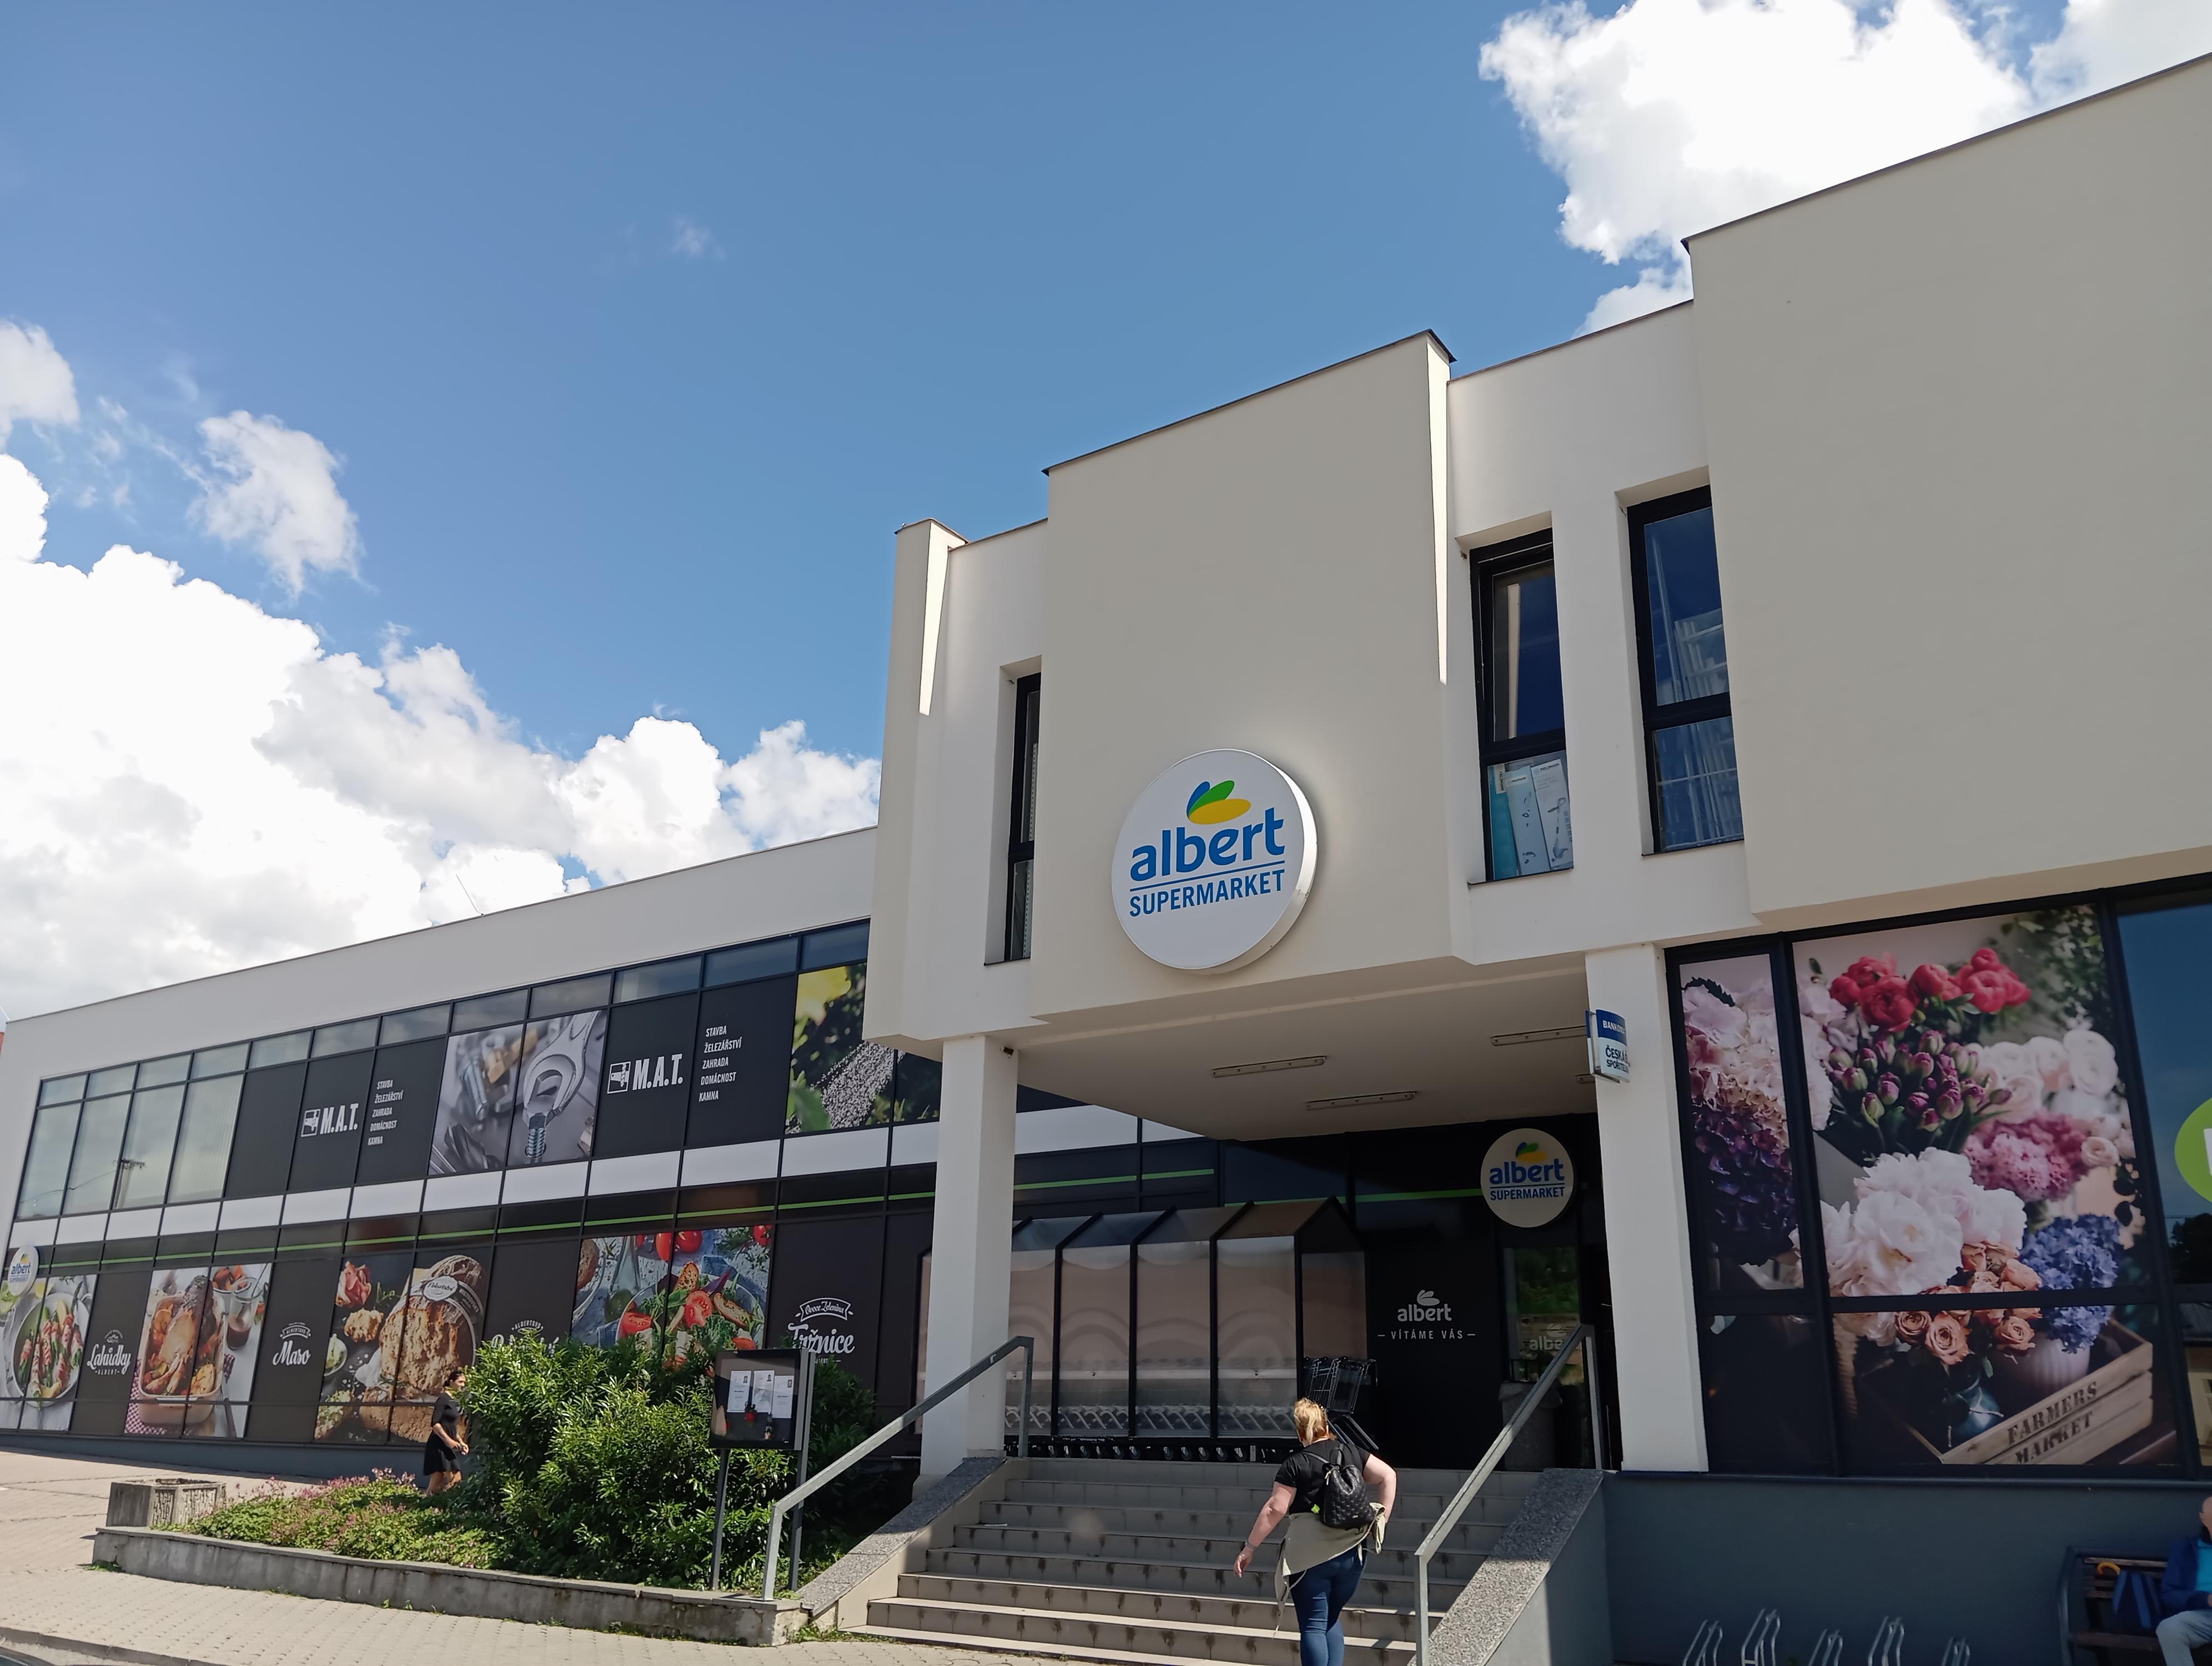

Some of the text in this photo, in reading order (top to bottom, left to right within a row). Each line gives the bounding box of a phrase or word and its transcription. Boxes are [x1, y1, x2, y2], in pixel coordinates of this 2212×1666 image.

[1130, 807, 1285, 882] albert
[1130, 869, 1285, 917] SUPERMARKET
[706, 1025, 727, 1037] STAVBA
[704, 1037, 742, 1053] ŽELEZÁŘSTVÍ
[702, 1057, 728, 1070] ZAHRADA
[632, 1053, 683, 1091] M.A.T.
[701, 1072, 737, 1086] DOMÁCNOST
[376, 1080, 393, 1090] STAVBA
[699, 1090, 718, 1102] KAMNA
[320, 1103, 359, 1135] M.A.T.
[372, 1107, 393, 1118] ZAHRADA
[370, 1120, 398, 1132] DOMÁCNOST
[368, 1136, 383, 1146] KAMNA
[1489, 1158, 1565, 1185] albert
[1490, 1187, 1565, 1201] SUPERMARKET
[11, 1262, 31, 1274] albert
[1397, 1303, 1452, 1321] albert
[1391, 1328, 1463, 1339] VÍTÁME VÁS
[1530, 1336, 1580, 1351] albe
[273, 1340, 311, 1366] Maso
[2007, 1381, 2097, 1445] FARMERS
[2015, 1411, 2093, 1464] MARKET
